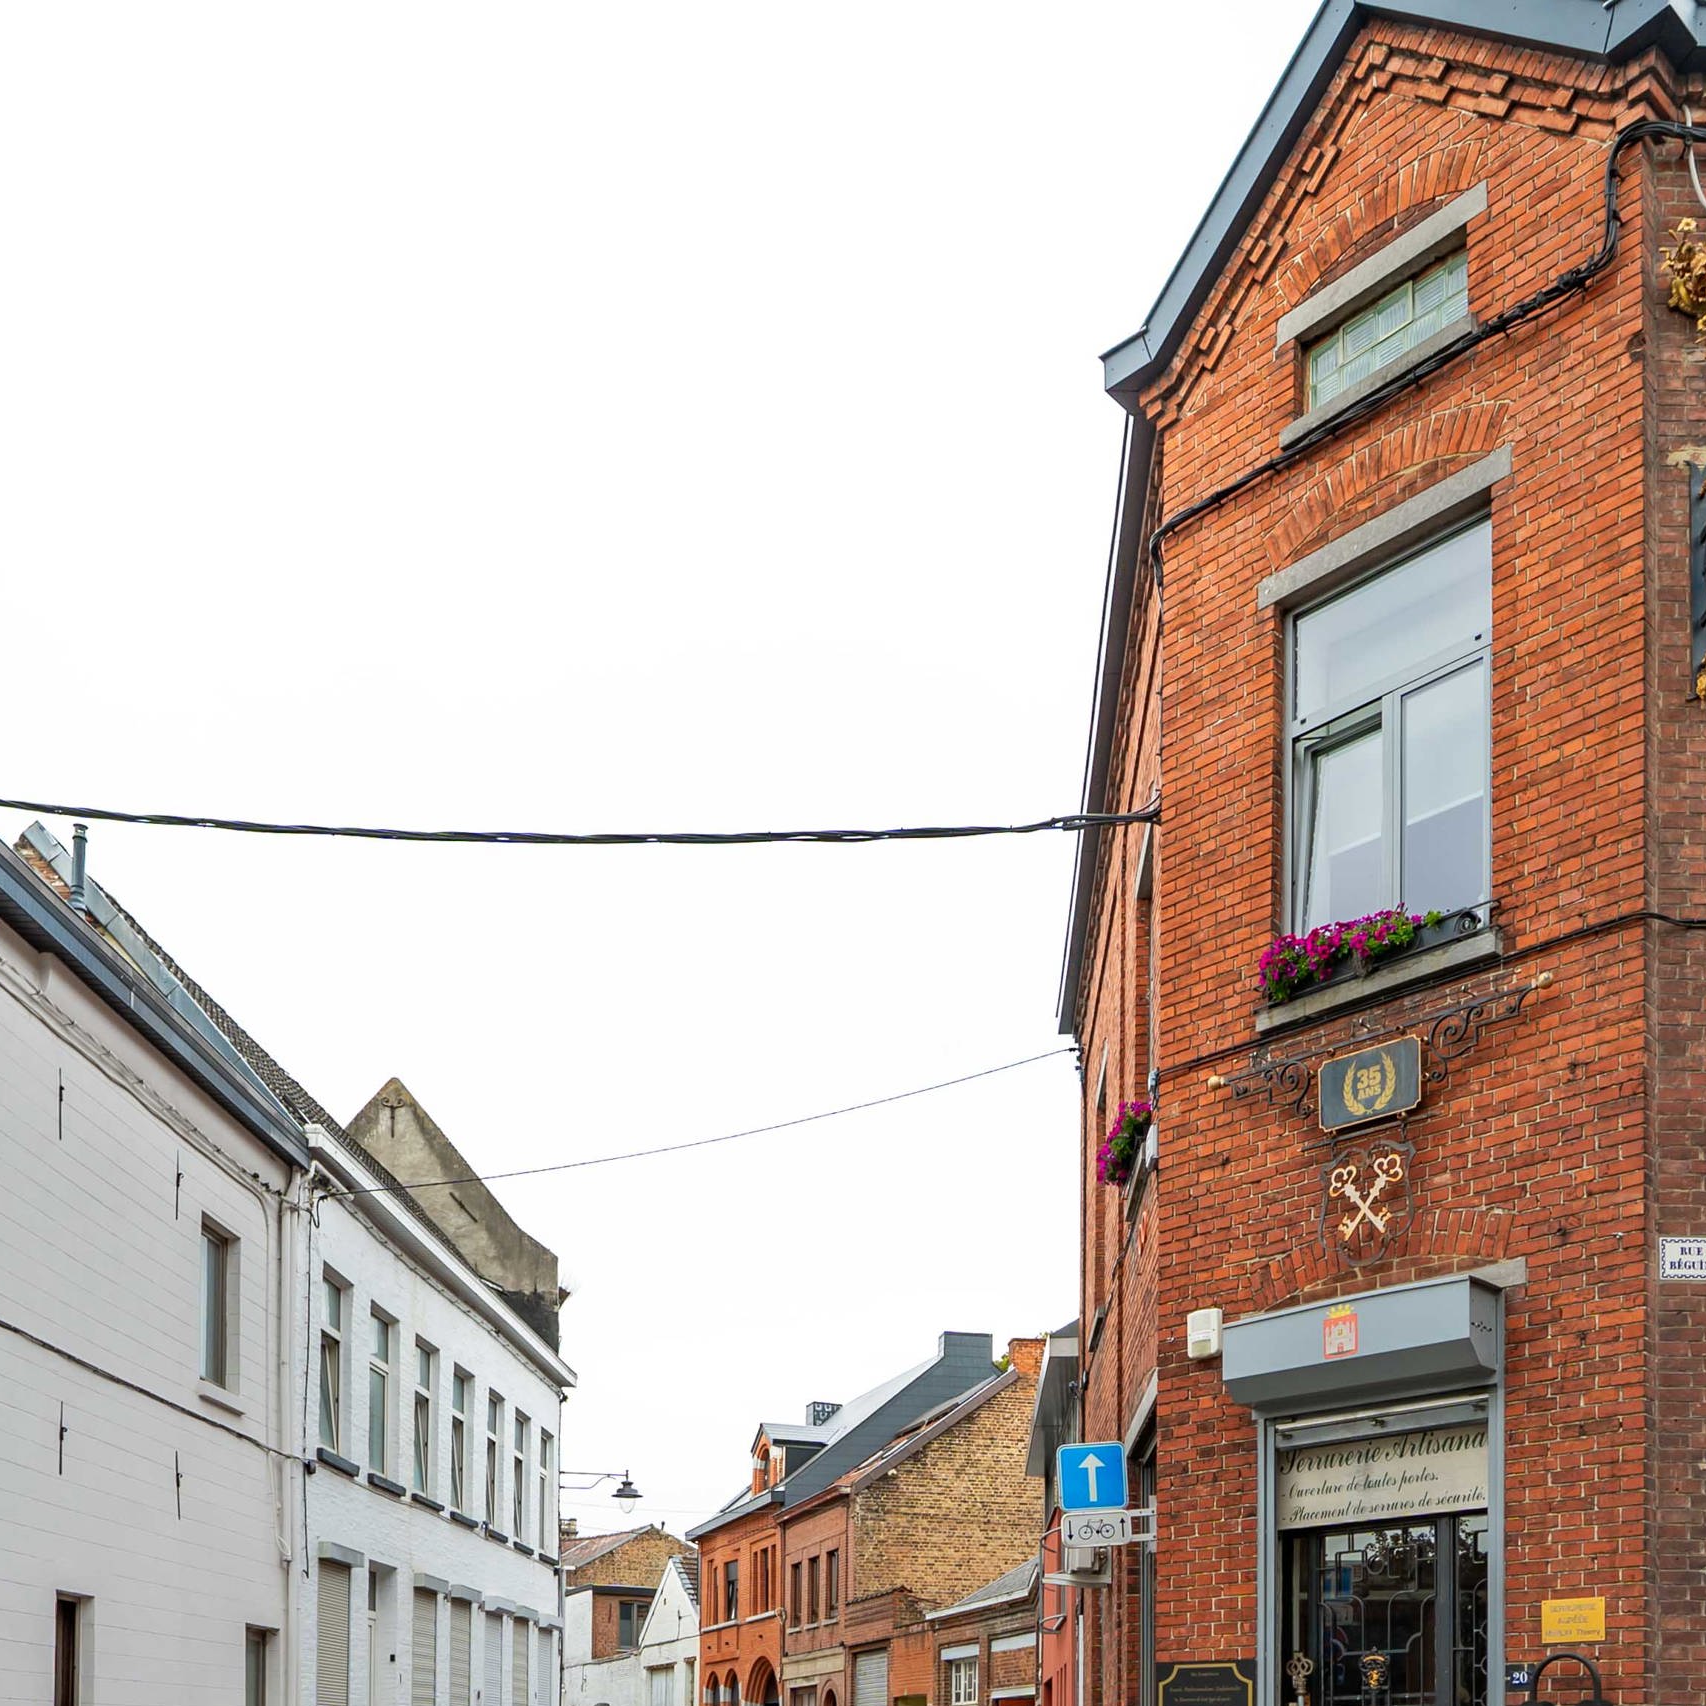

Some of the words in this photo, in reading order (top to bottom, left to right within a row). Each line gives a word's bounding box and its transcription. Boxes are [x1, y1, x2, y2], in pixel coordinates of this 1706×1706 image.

[1357, 1064, 1381, 1089] 35
[1358, 1084, 1381, 1100] ANS
[1680, 1246, 1703, 1256] RUE
[1385, 1432, 1489, 1461] Artisana
[1289, 1480, 1343, 1499] Ouverture
[1346, 1476, 1360, 1491] de
[1363, 1472, 1397, 1491] toutes
[1398, 1467, 1439, 1492] portes.
[1290, 1500, 1352, 1522] Placement
[1353, 1500, 1365, 1515] de
[1369, 1500, 1415, 1514] serrures
[1418, 1491, 1431, 1508] de
[1435, 1486, 1486, 1506] sécurité.
[1512, 1671, 1528, 1684] 20
